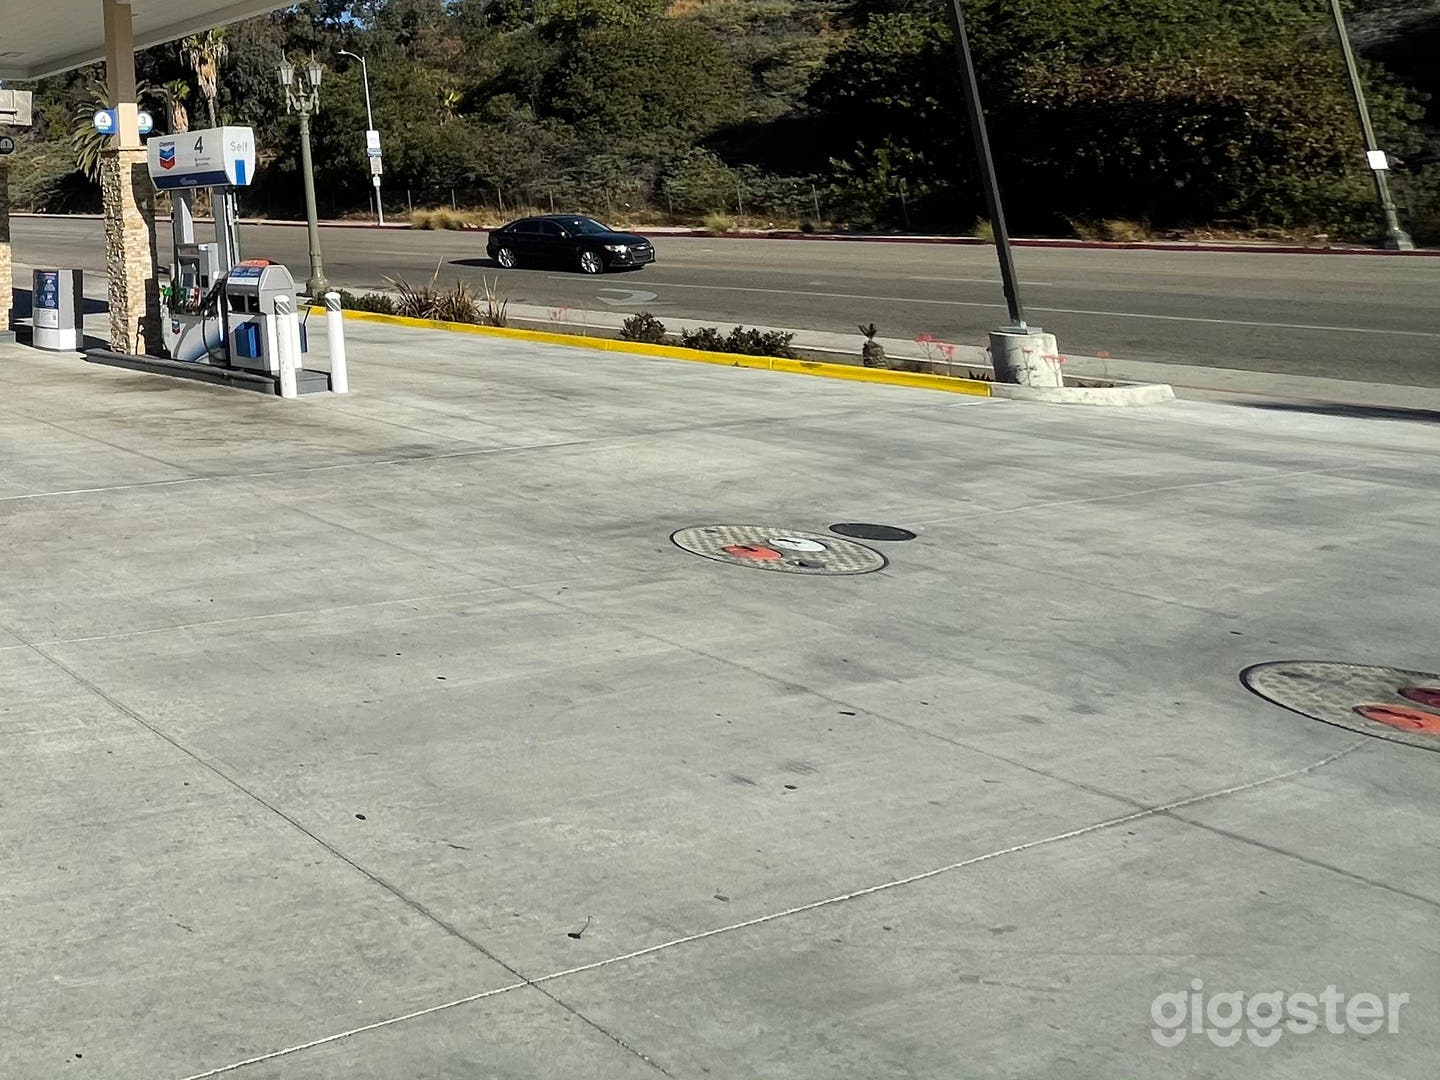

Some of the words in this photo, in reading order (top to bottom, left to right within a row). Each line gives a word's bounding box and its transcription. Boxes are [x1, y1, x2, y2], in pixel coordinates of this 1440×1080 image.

[99, 115, 106, 124] 4
[140, 116, 147, 124] 3
[193, 136, 204, 154] 4
[230, 141, 248, 152] Self
